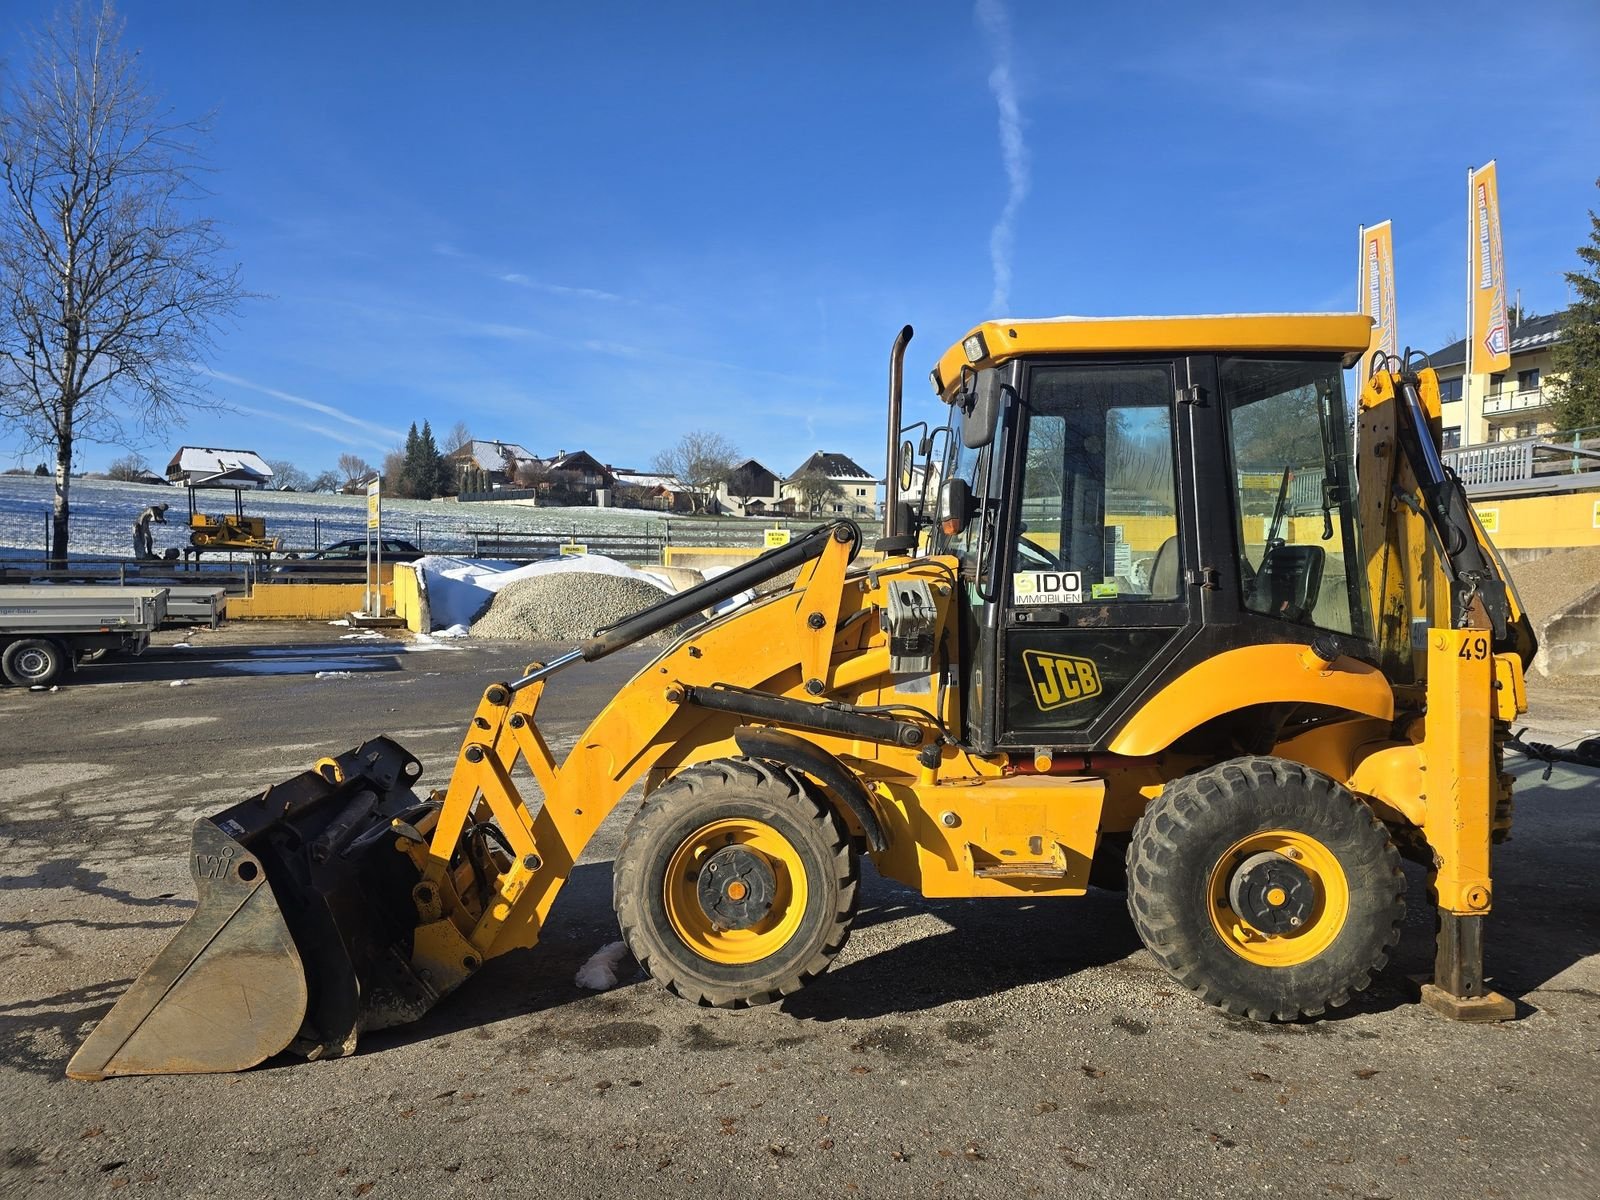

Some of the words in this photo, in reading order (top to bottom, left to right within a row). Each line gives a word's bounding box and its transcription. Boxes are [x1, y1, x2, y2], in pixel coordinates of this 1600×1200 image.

[1369, 240, 1378, 259] Bau
[1016, 573, 1080, 593] SIDO
[1016, 594, 1080, 604] IMMOBILIEN
[1458, 638, 1487, 660] 49
[1037, 656, 1097, 704] JCB
